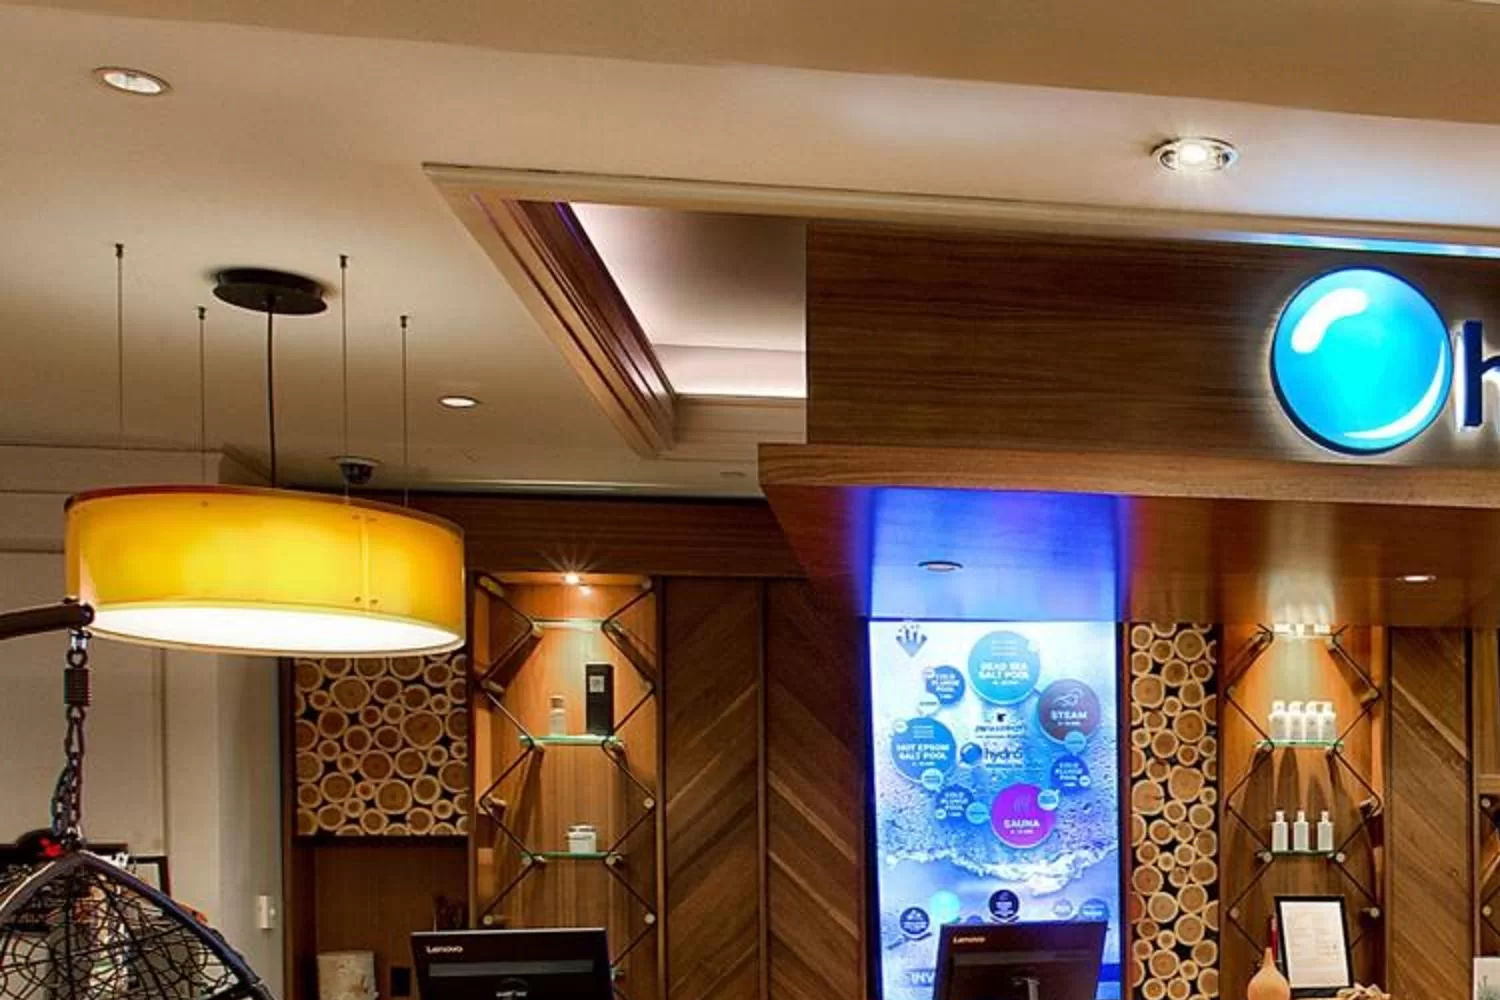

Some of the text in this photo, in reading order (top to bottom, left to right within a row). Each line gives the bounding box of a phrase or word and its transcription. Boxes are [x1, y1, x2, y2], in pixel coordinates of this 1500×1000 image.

[1051, 710, 1088, 721] STEAM
[1003, 818, 1040, 829] SAUNA
[953, 936, 986, 944] Lenovo
[425, 945, 463, 954] Lenovo
